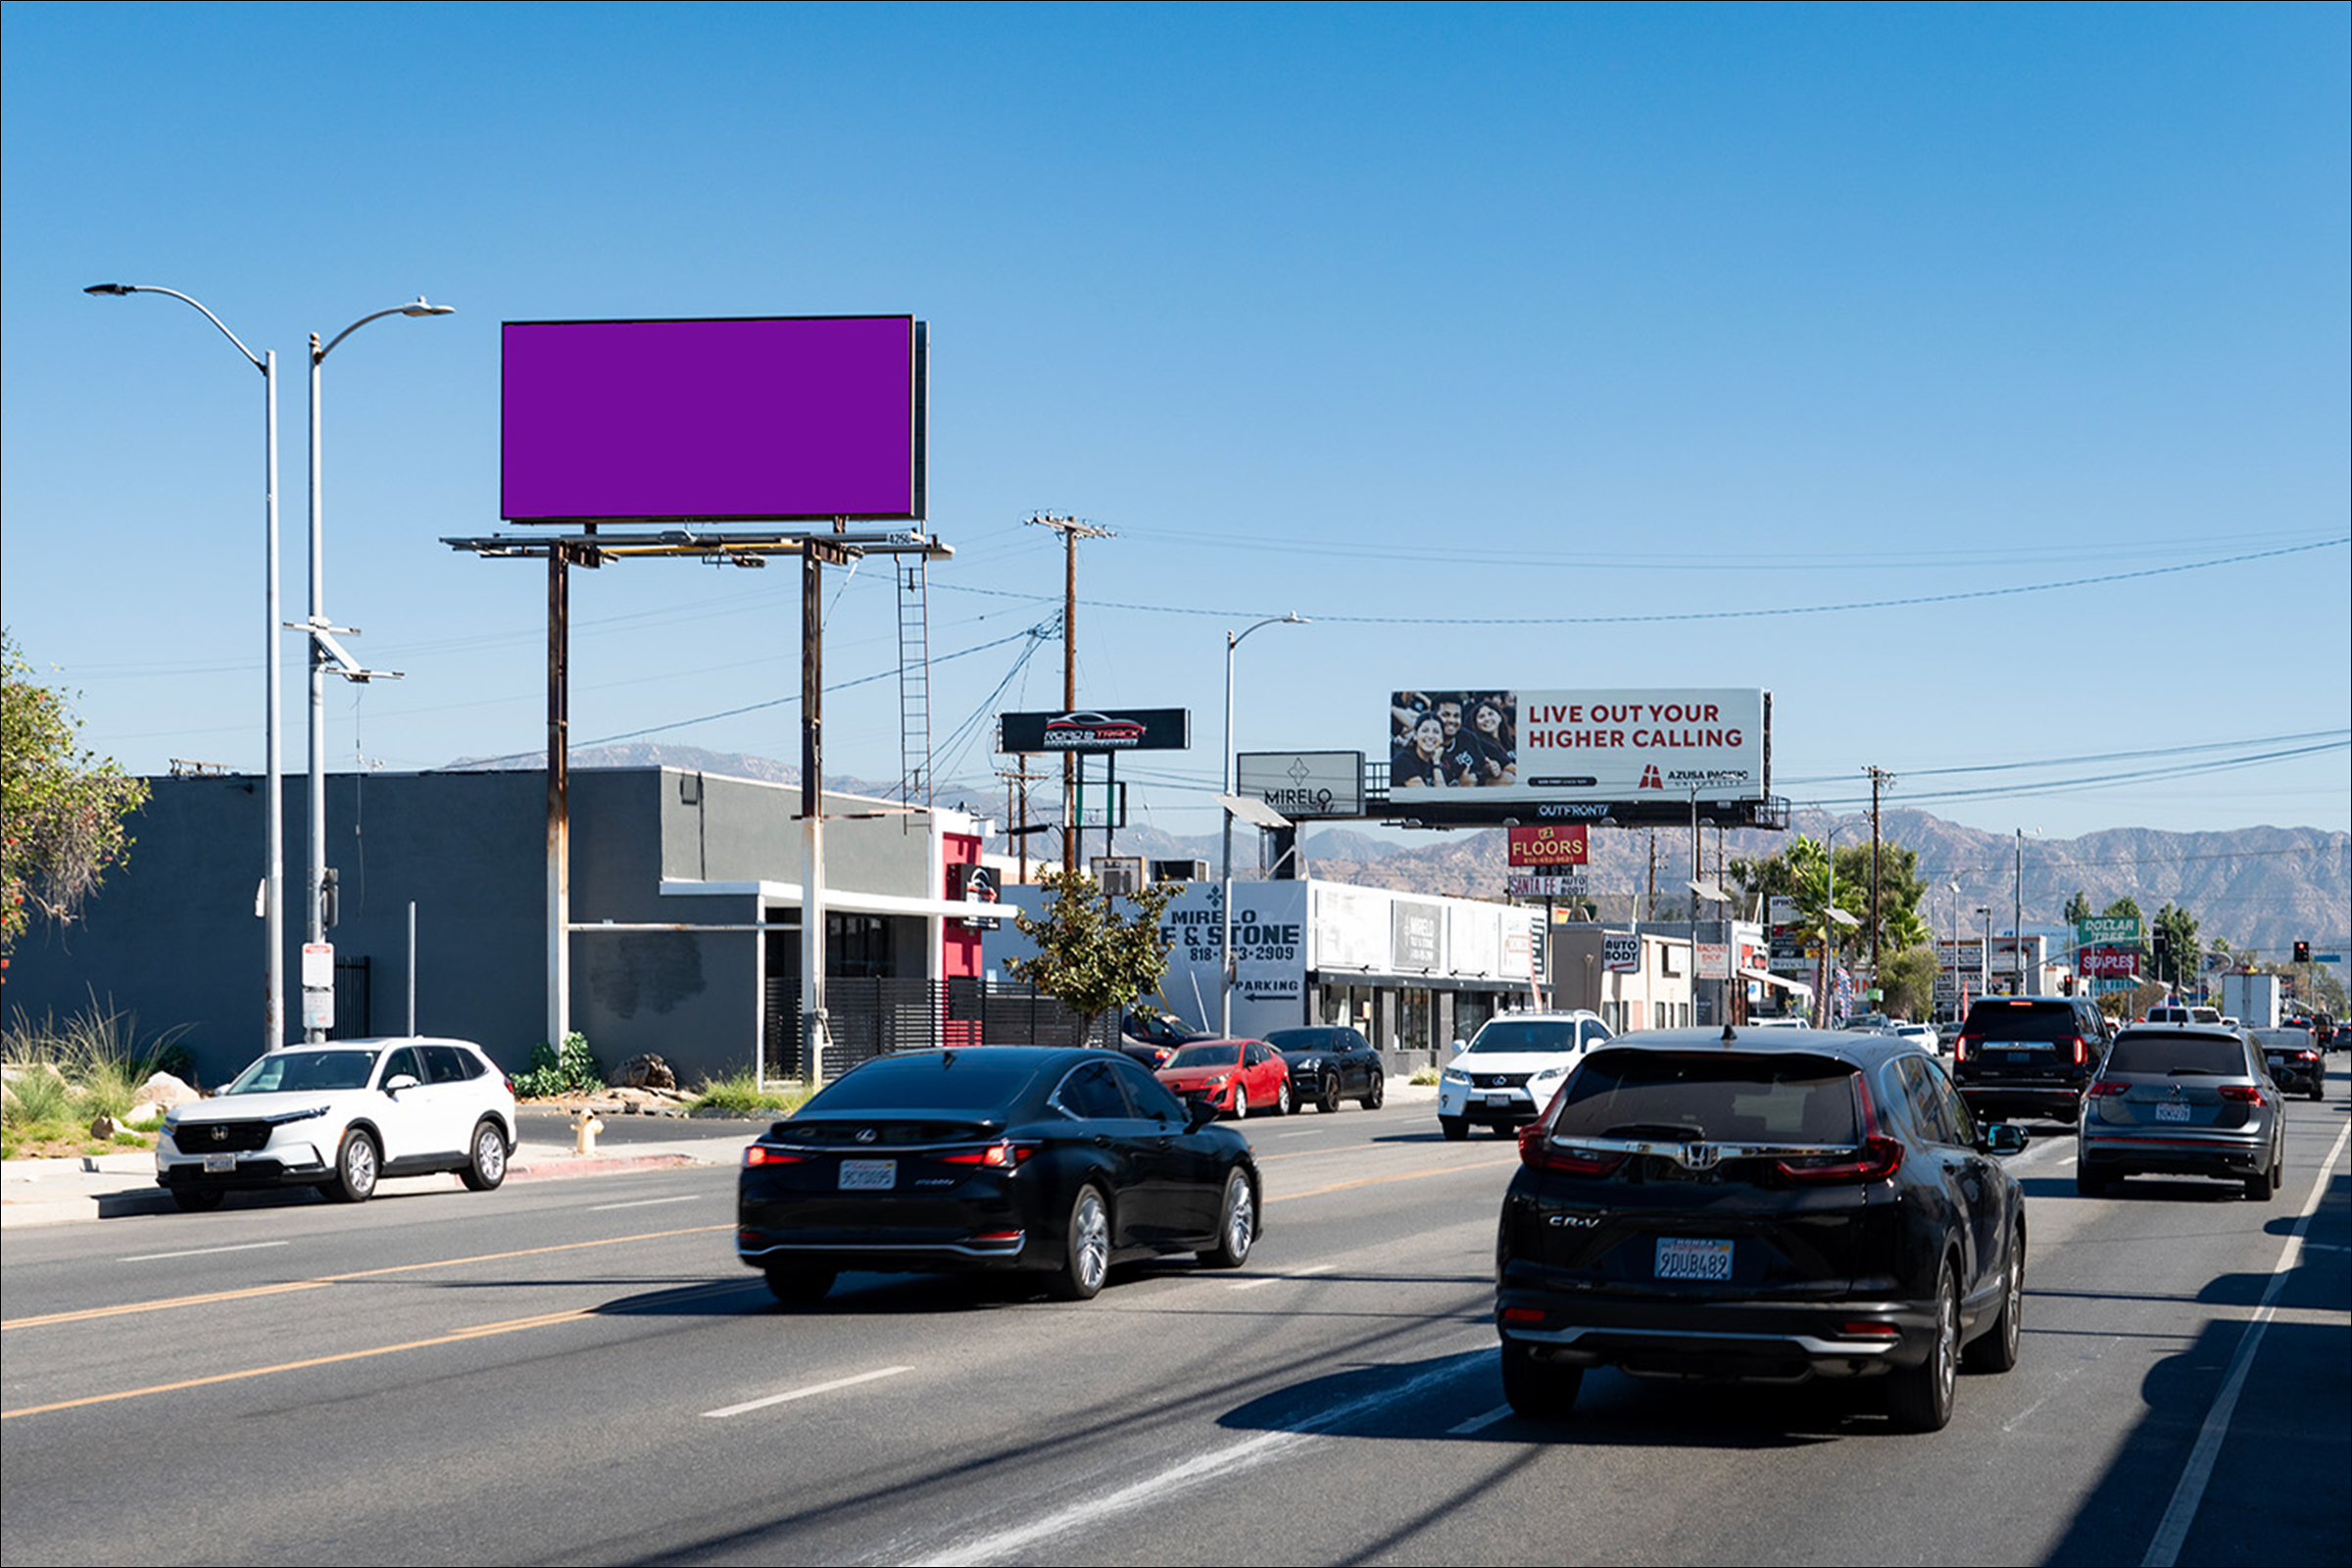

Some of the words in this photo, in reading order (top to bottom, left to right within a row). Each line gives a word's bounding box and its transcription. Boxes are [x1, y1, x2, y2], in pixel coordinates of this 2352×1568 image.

[1529, 706, 1583, 723] LIVE
[1590, 705, 1642, 722] OUT
[1648, 705, 1719, 722] YOUR
[1096, 729, 1140, 739] TRACK
[1529, 730, 1624, 748] HIGHER
[1631, 729, 1742, 747] CALLING
[1668, 770, 1705, 779] AZUSA
[1264, 788, 1332, 805] MIRELO
[1512, 840, 1583, 857] FLOORS
[1510, 877, 1541, 895] SANTA
[1544, 877, 1556, 894] FE
[2084, 920, 2133, 930] DOLLAR
[1184, 926, 1200, 946] &
[2092, 932, 2125, 942] TREE
[1606, 941, 1637, 951] AUTO
[1605, 951, 1637, 960] BODY
[2083, 956, 2134, 968] STAPLES
[1236, 981, 1298, 991] PARKING
[1549, 1216, 1599, 1228] CR-V
[1659, 1253, 1728, 1274] 9DUB489
